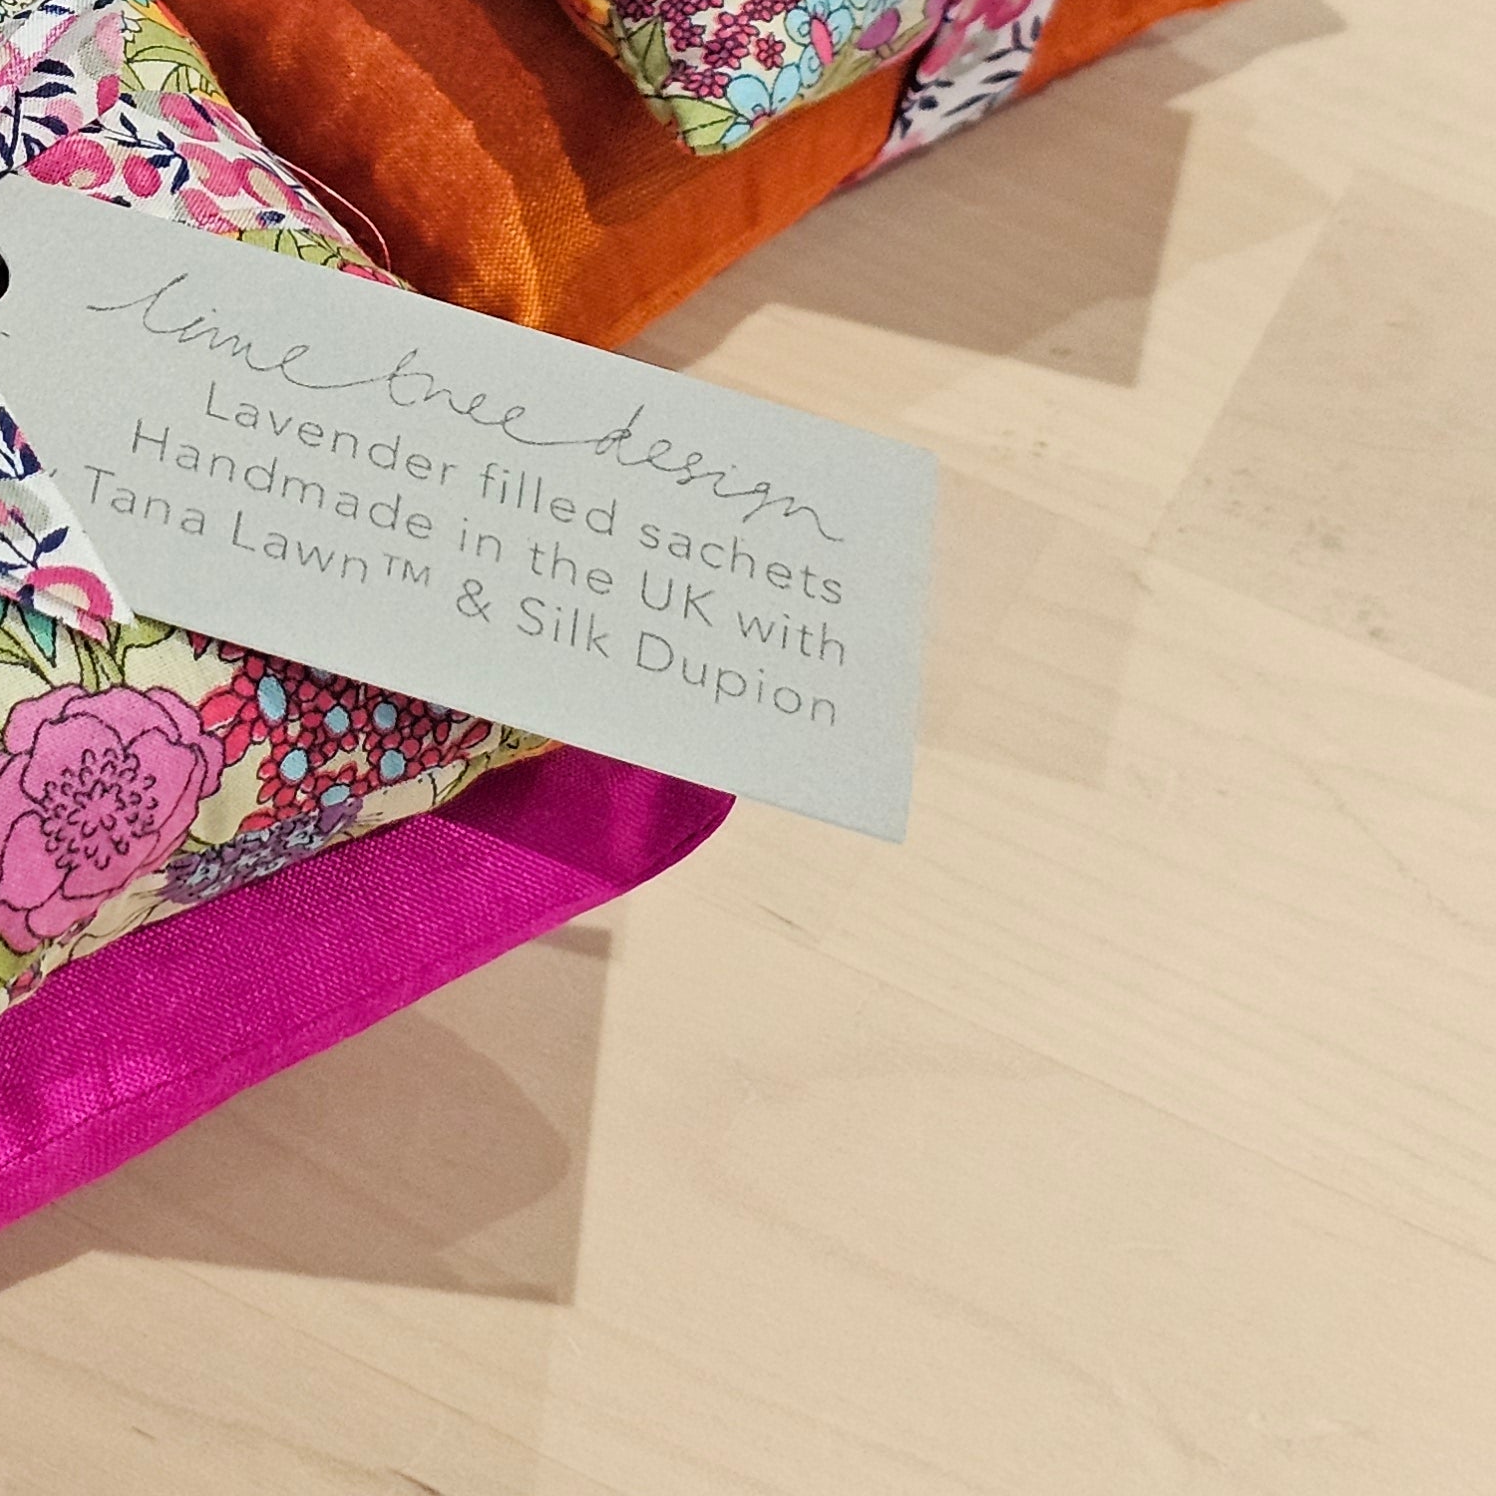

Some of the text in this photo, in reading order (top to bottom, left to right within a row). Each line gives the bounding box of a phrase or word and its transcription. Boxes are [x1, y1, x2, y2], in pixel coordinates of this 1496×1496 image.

[87, 273, 846, 543] lime tree design
[204, 381, 844, 605] Lavender filled sachets
[84, 464, 206, 536] Tana
[455, 578, 491, 623] &
[516, 596, 610, 659] Silk
[635, 632, 837, 726] Dupion
[131, 418, 847, 666] Handmade in the UK with
